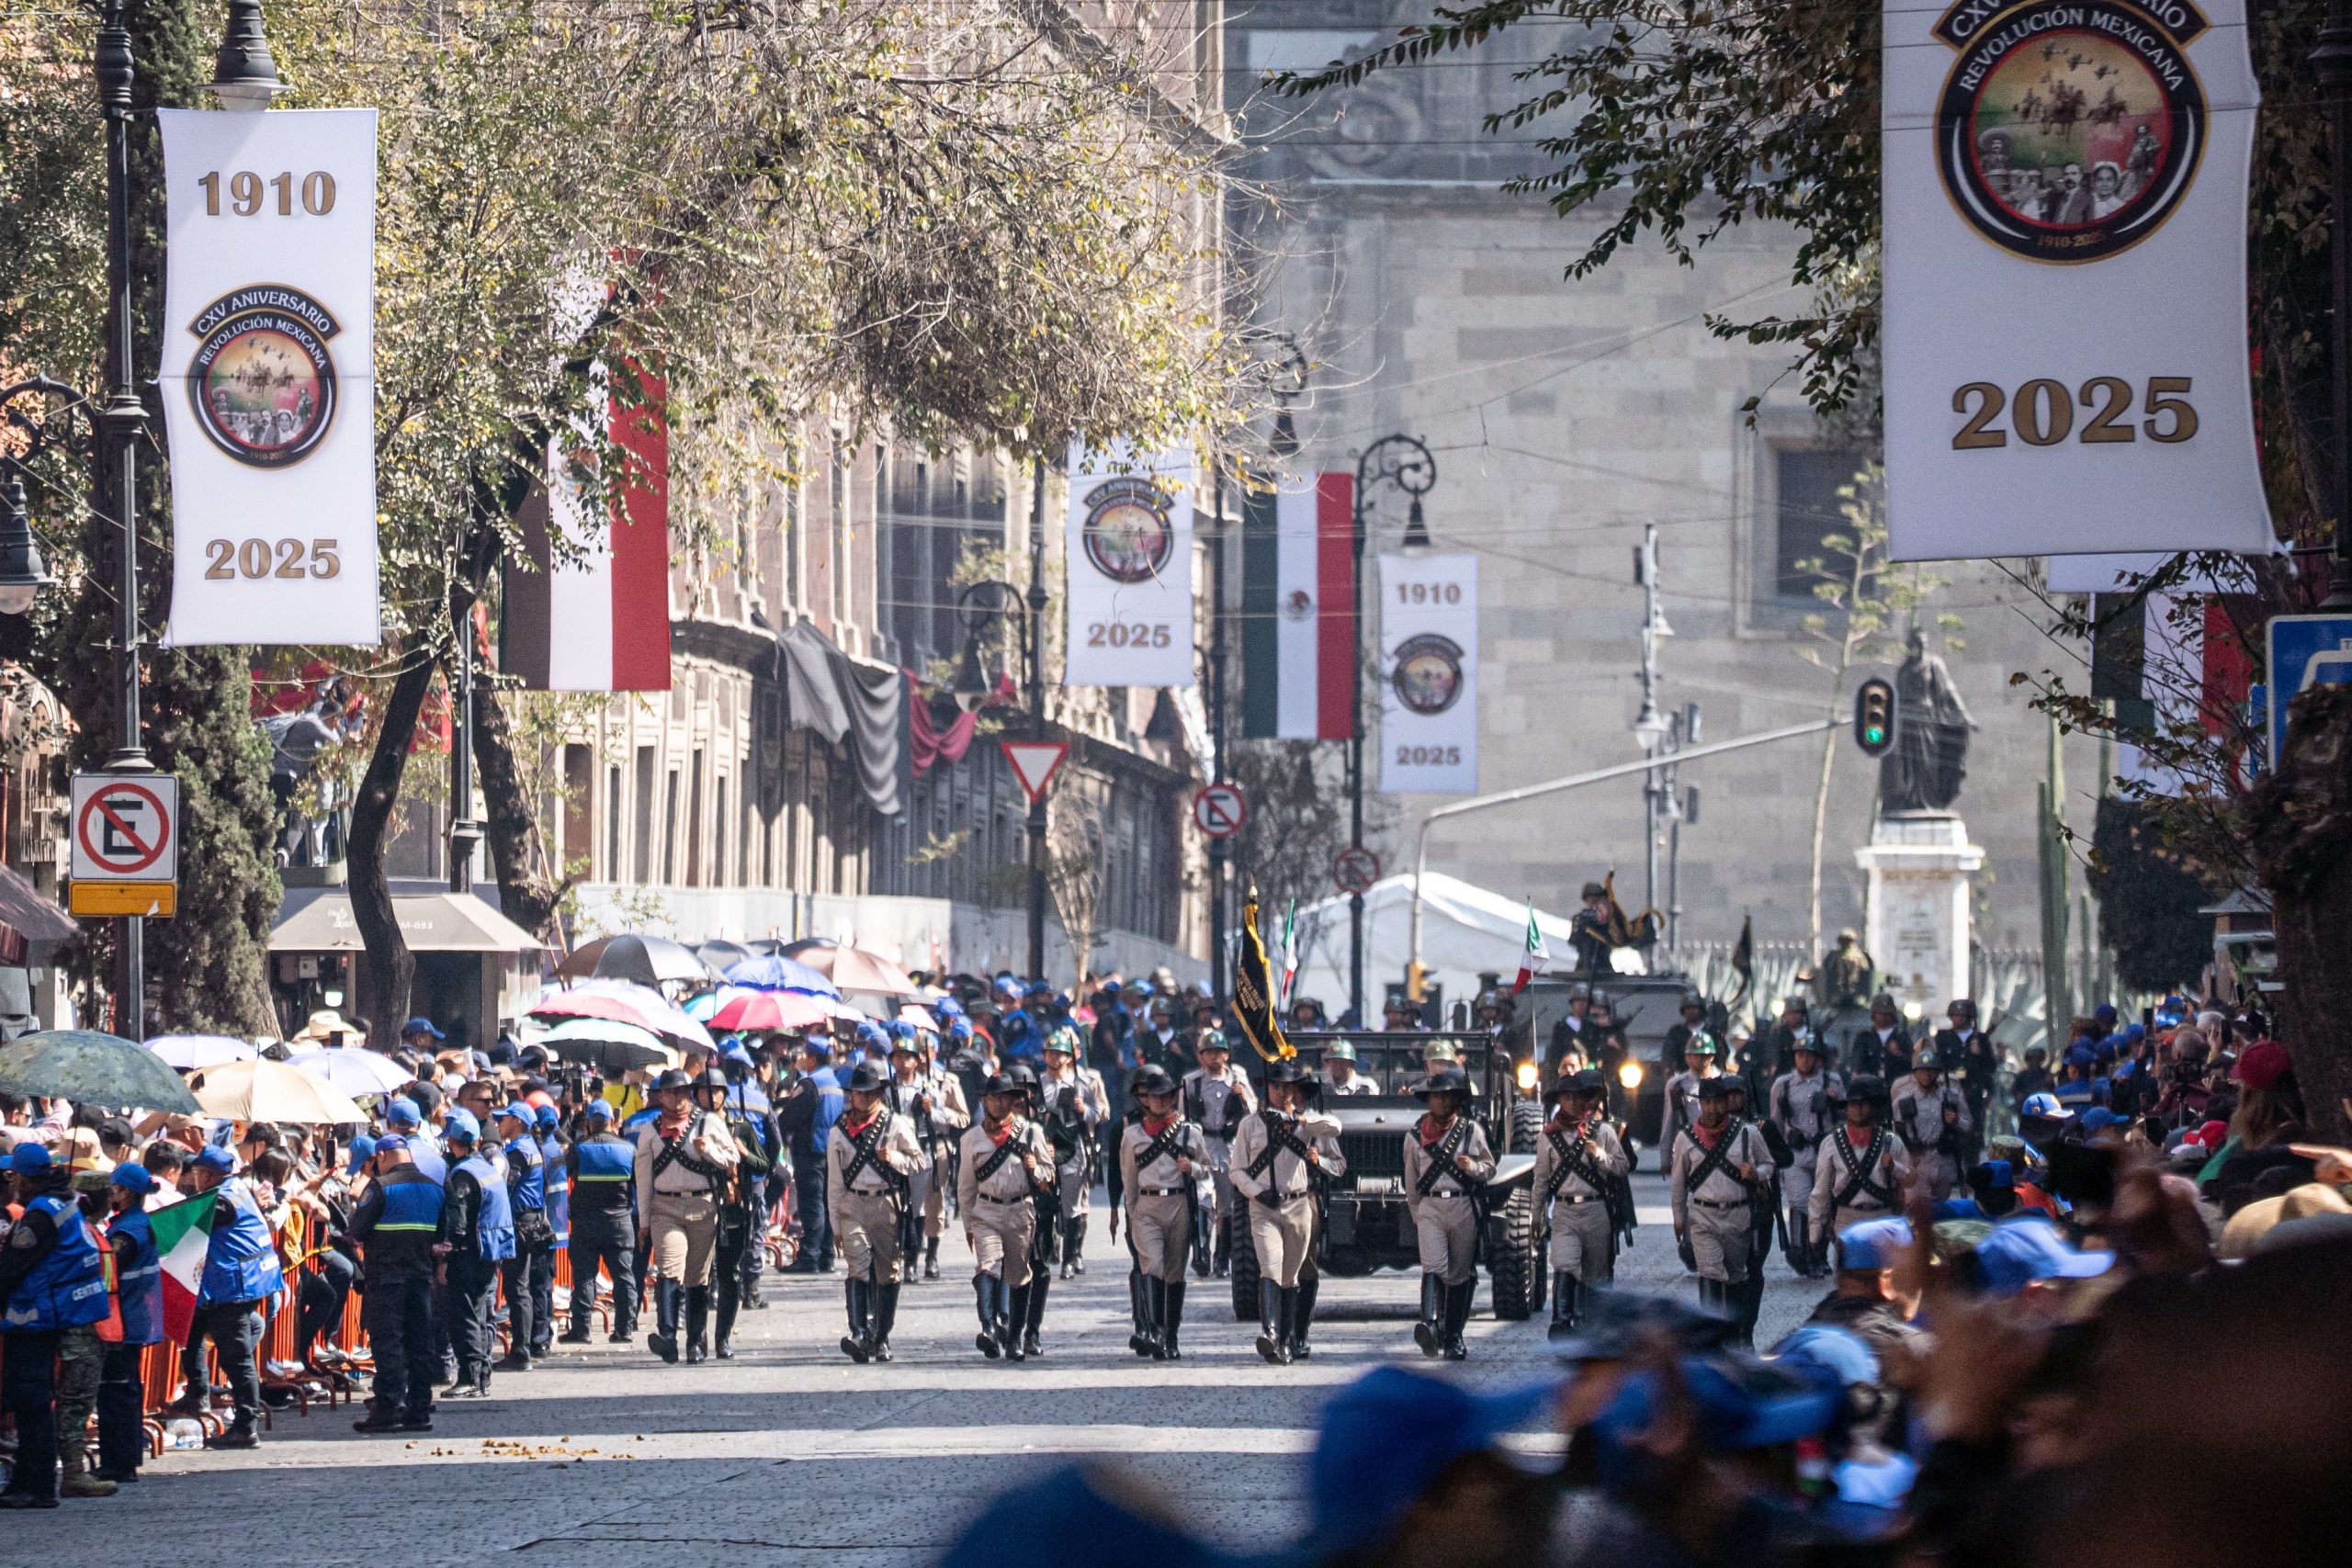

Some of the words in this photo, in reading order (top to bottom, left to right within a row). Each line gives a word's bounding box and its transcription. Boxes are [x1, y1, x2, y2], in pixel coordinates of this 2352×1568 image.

[1959, 6, 2084, 92] REVOLUCIÓN
[2089, 12, 2185, 91] MEXICANA
[198, 171, 336, 217] 1910
[197, 303, 226, 333] CXV
[232, 291, 330, 333] ANIVERSARIO
[199, 315, 273, 366] REVOLUCIÓN
[276, 319, 326, 368] MEXICANA
[1951, 376, 2199, 450] 2025
[205, 538, 341, 580] 2025
[1397, 582, 1460, 604] 1910
[1088, 624, 1171, 649] 2025
[1396, 746, 1461, 766] 2025
[103, 801, 143, 855] E
